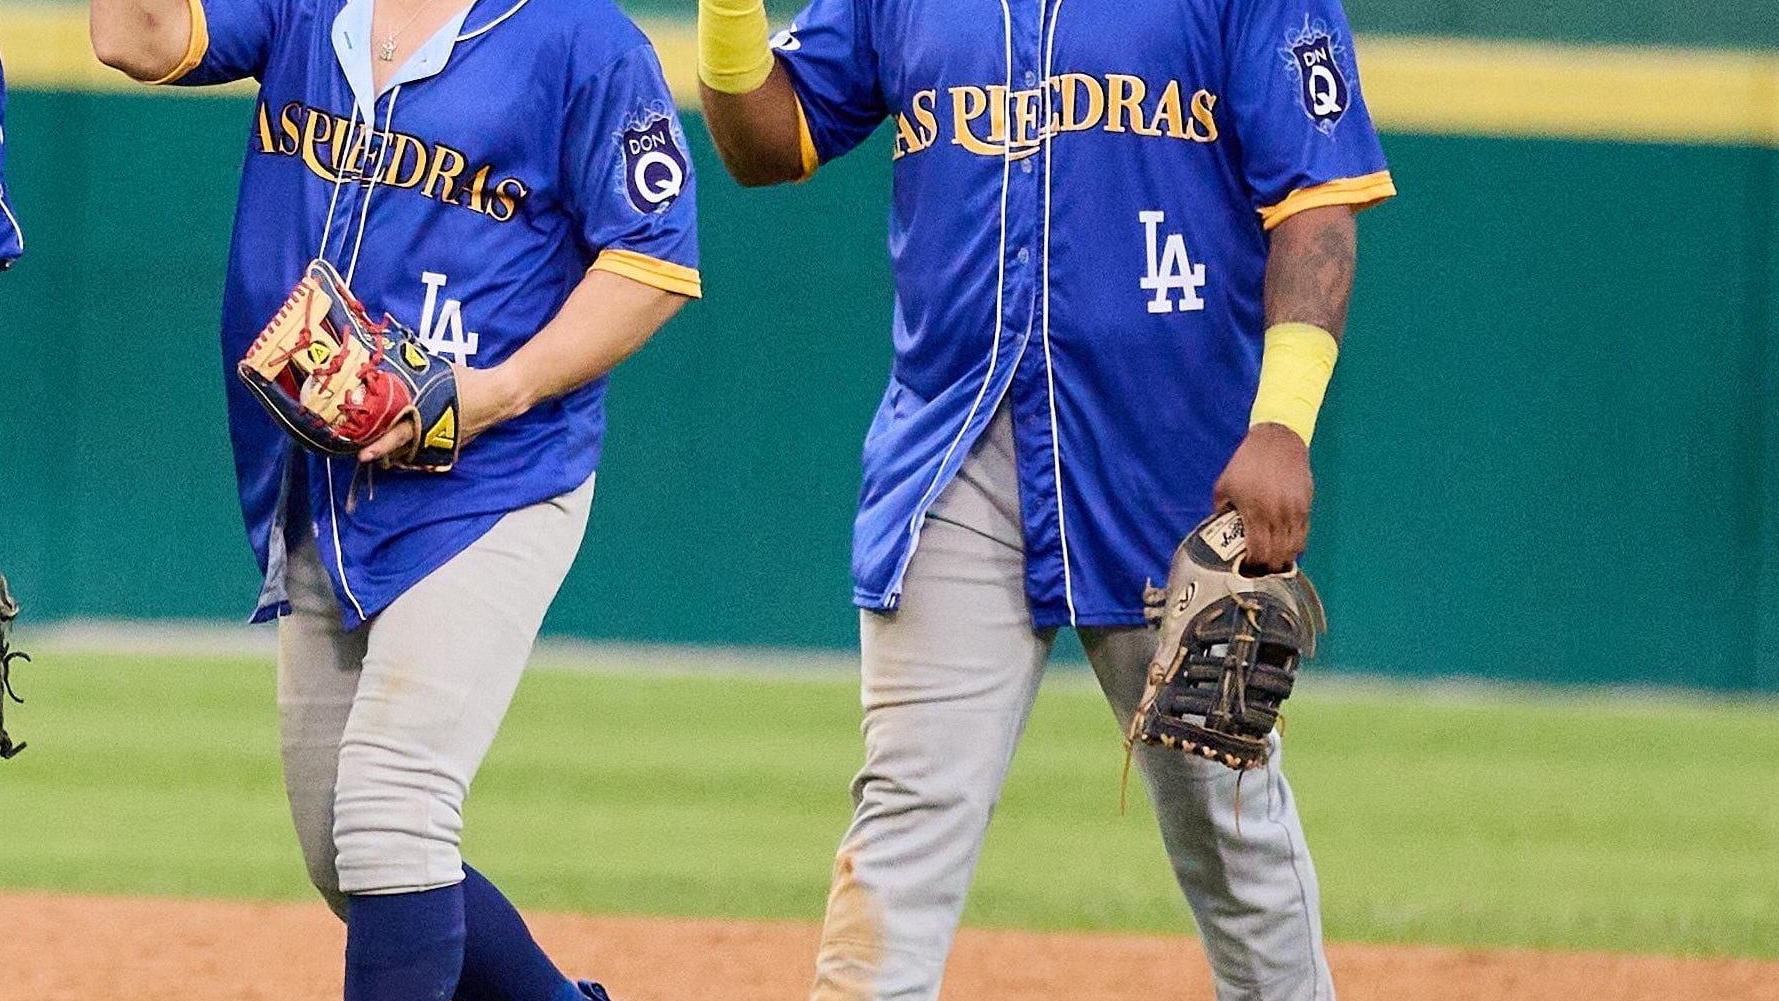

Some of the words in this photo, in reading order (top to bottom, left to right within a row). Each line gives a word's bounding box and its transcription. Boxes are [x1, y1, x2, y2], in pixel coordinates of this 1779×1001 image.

[892, 89, 936, 161] AS
[948, 72, 1218, 162] PIEDRAS
[1308, 64, 1343, 116] Q
[629, 131, 666, 155] DON
[634, 151, 683, 204] Q
[1138, 210, 1205, 314] LA
[419, 271, 479, 369] LA
